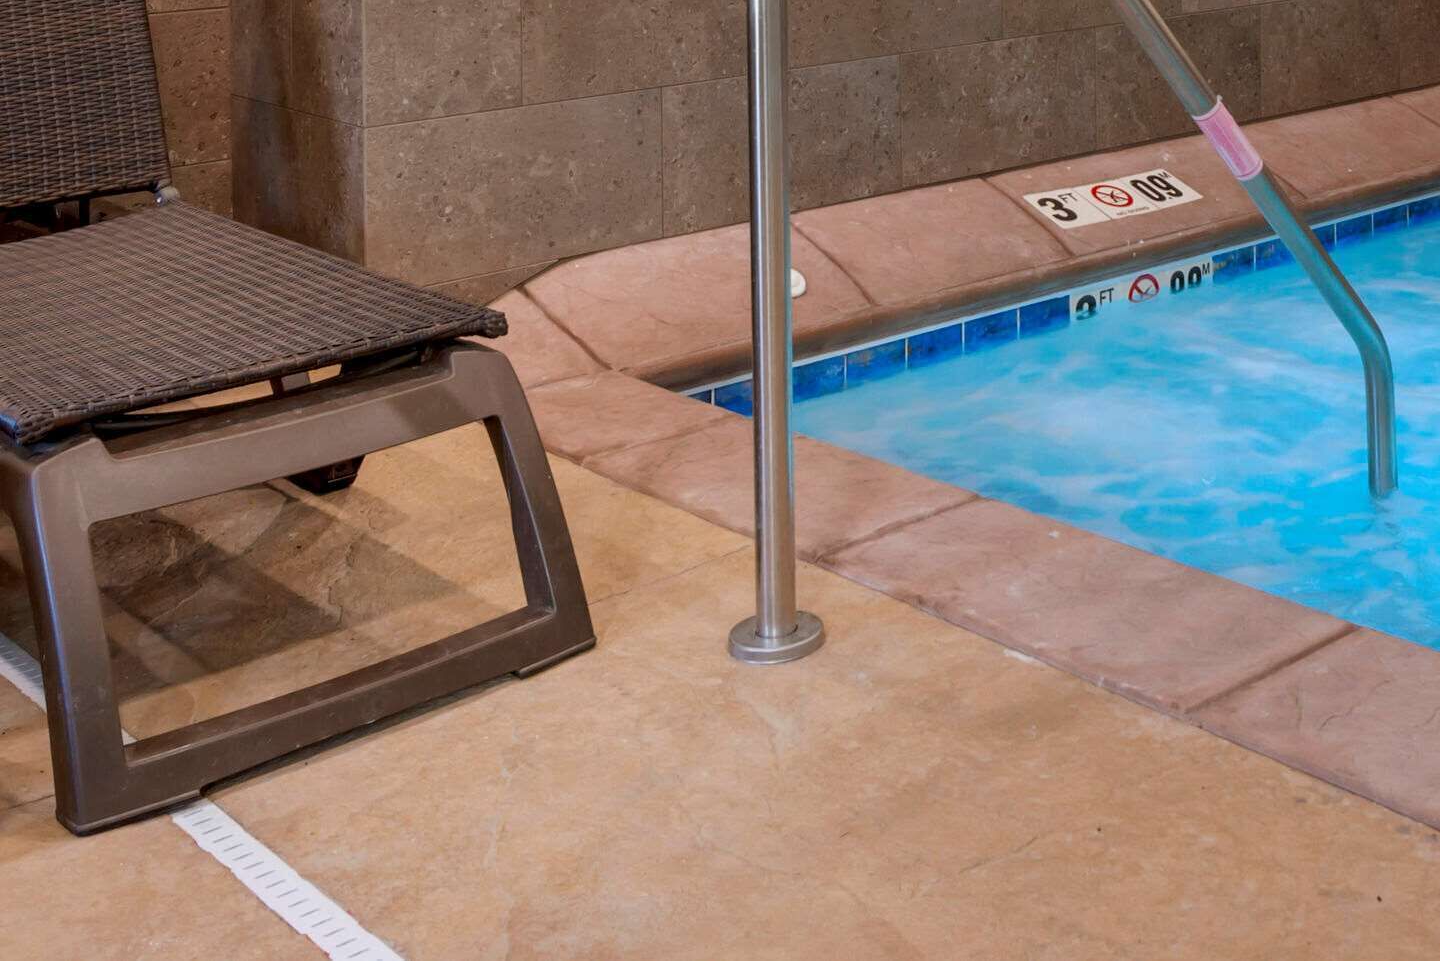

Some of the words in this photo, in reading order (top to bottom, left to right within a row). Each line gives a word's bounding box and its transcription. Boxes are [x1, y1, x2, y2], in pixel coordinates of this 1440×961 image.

[1037, 197, 1078, 221] 3
[1057, 192, 1079, 205] FT
[1099, 287, 1115, 306] FT
[1202, 262, 1211, 275] M
